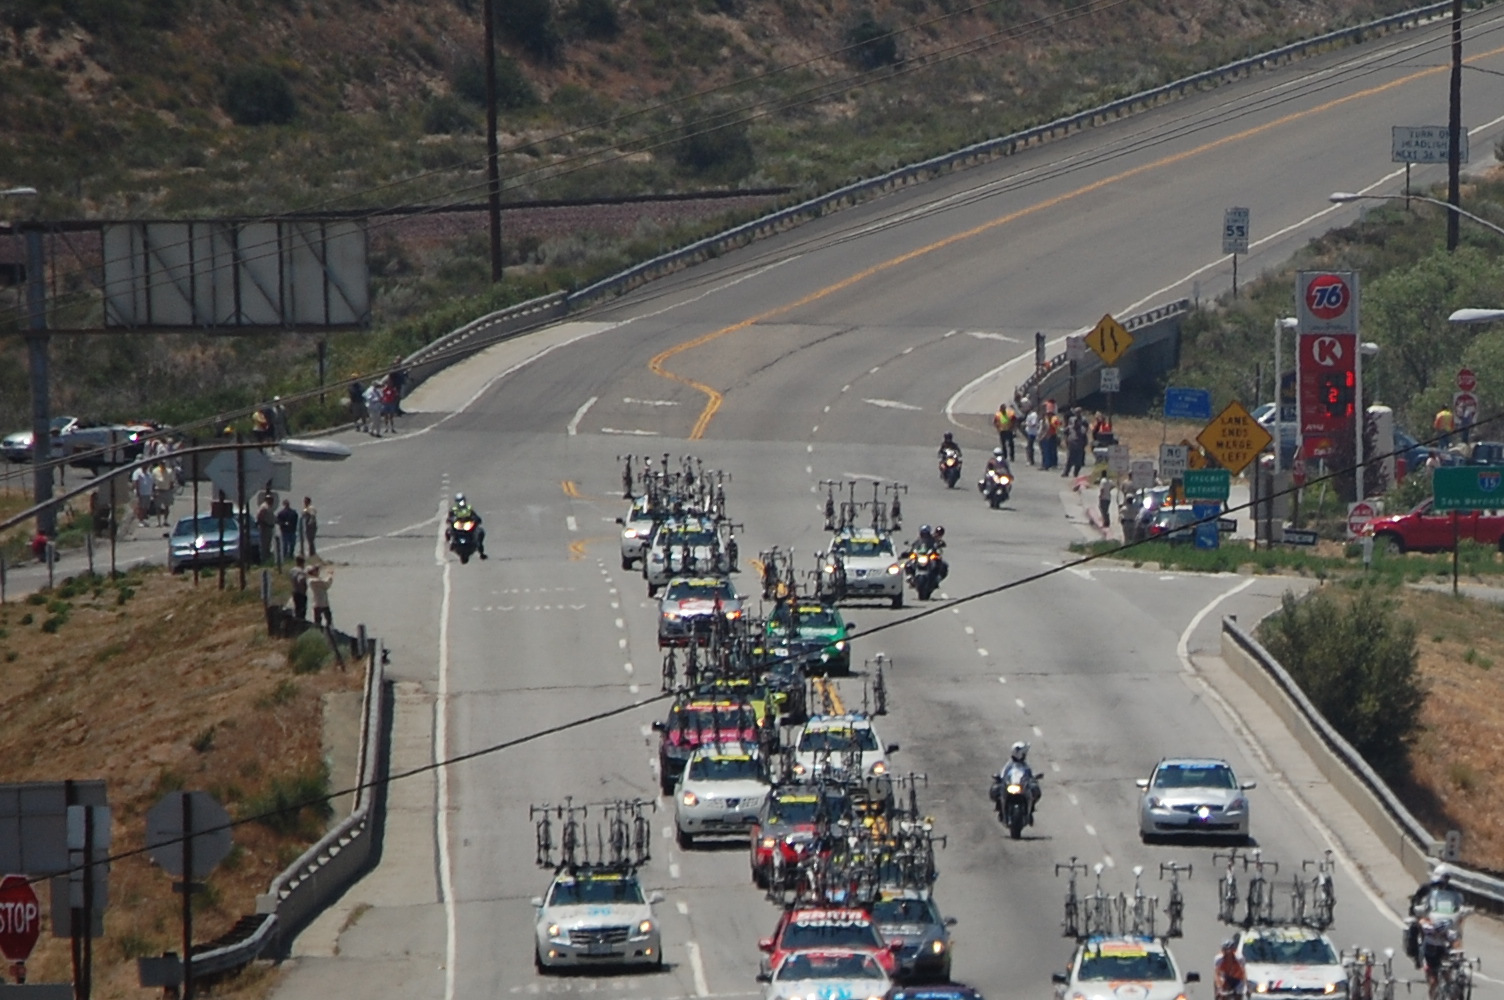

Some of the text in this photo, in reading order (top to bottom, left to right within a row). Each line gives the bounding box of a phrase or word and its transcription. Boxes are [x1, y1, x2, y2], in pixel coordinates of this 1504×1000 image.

[1226, 225, 1245, 237] 55
[1312, 283, 1342, 309] 76
[1313, 337, 1342, 366] K
[1220, 416, 1249, 426] LANE
[1221, 428, 1248, 438] ENDS
[1216, 440, 1253, 450] MERGE
[1166, 448, 1181, 458] NO
[1221, 452, 1248, 462] LEFT
